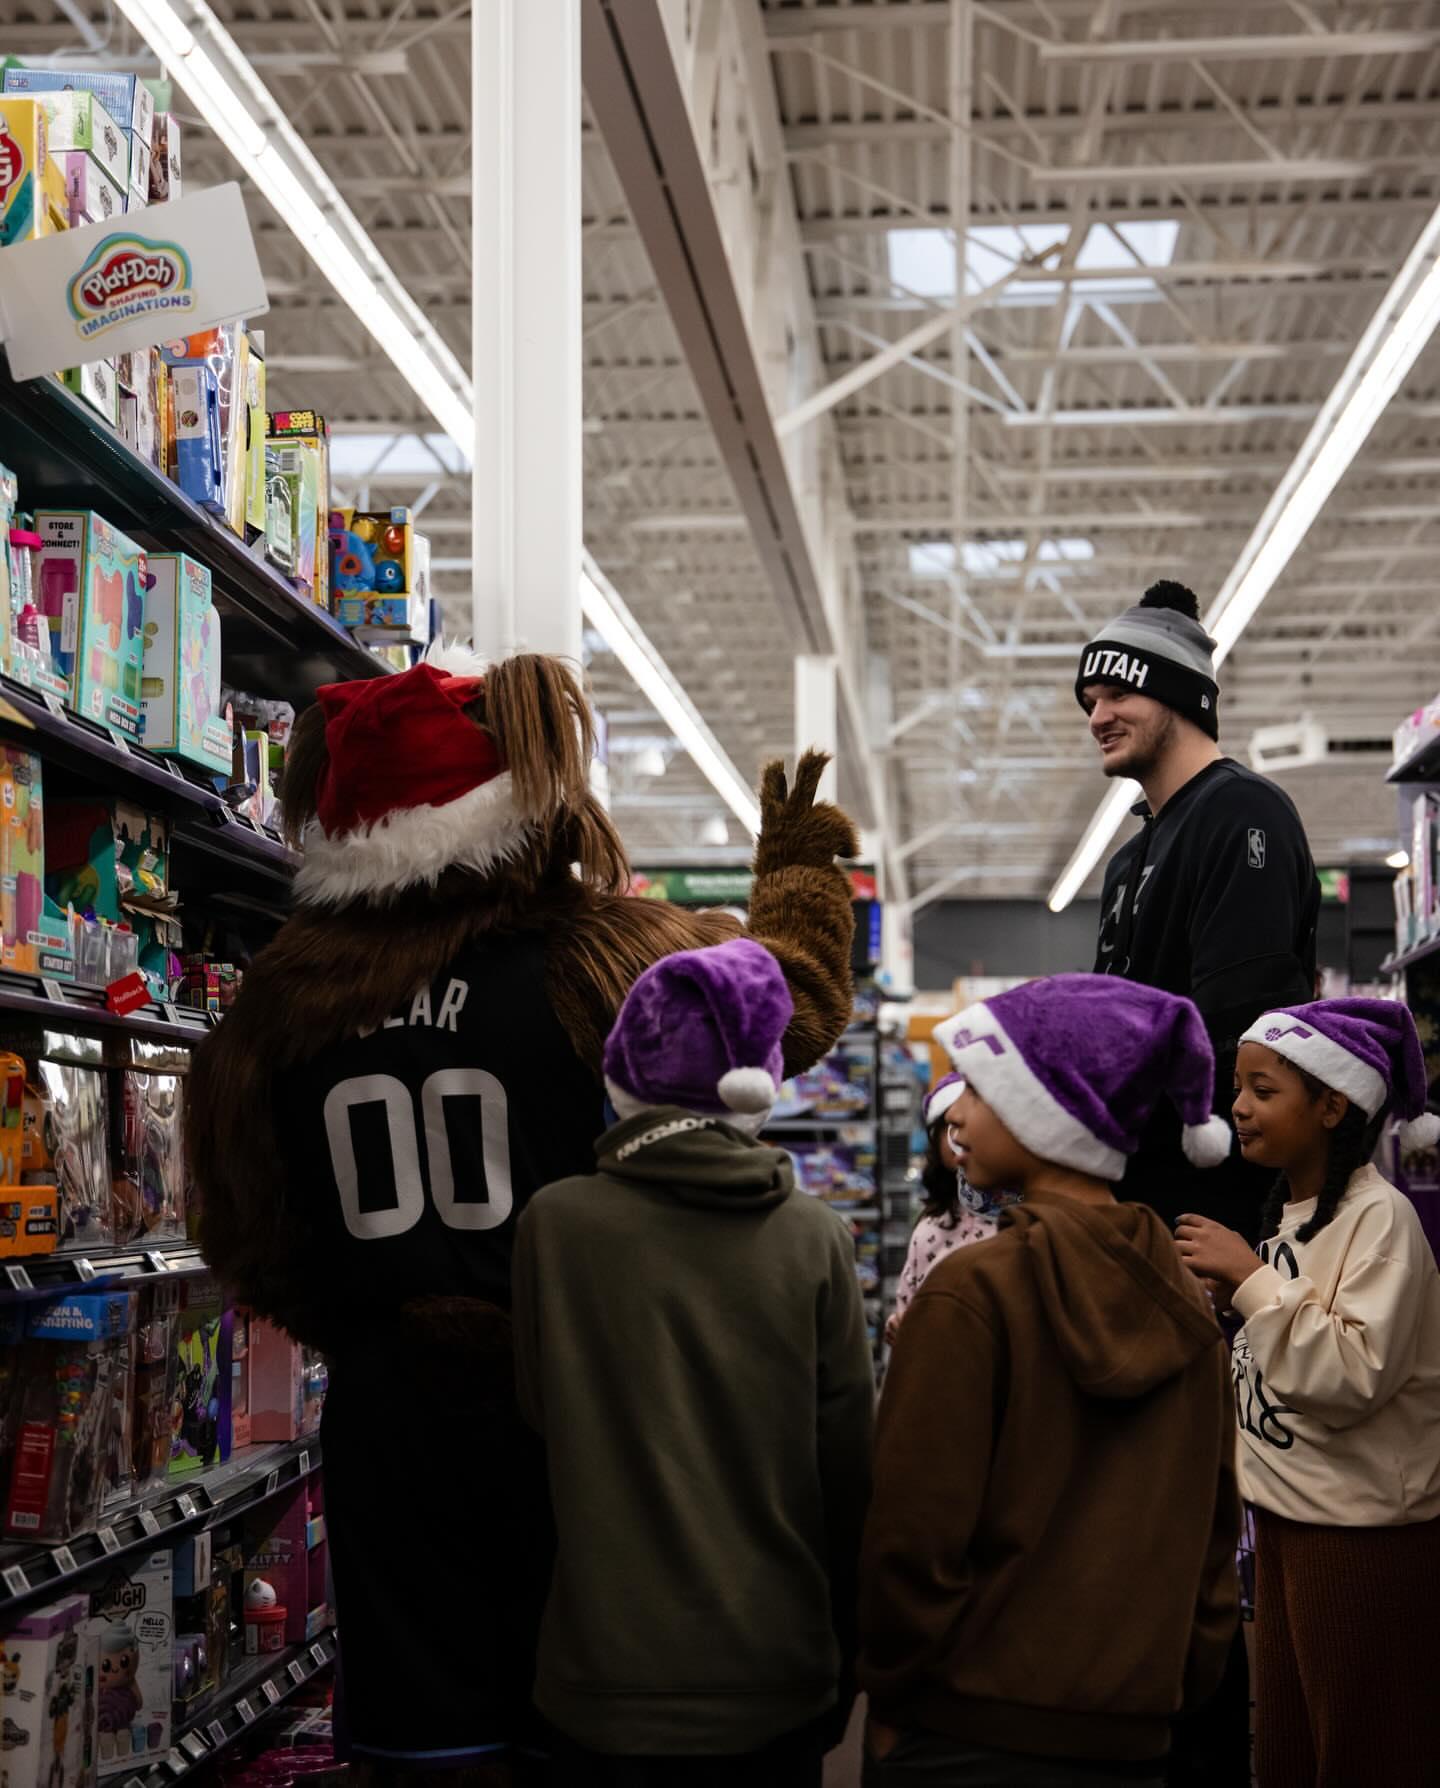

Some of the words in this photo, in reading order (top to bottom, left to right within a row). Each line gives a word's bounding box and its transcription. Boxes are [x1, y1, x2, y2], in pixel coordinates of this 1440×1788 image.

[83, 255, 171, 301] Play-Doh
[81, 294, 192, 336] IMAGINATIONS
[109, 288, 158, 308] SHAPING
[48, 521, 74, 530] STORE
[1082, 650, 1149, 689] UTAH
[357, 976, 470, 1040] AR
[322, 1066, 514, 1241] 00
[92, 1588, 142, 1612] DUGH
[142, 1617, 165, 1626] HELLO
